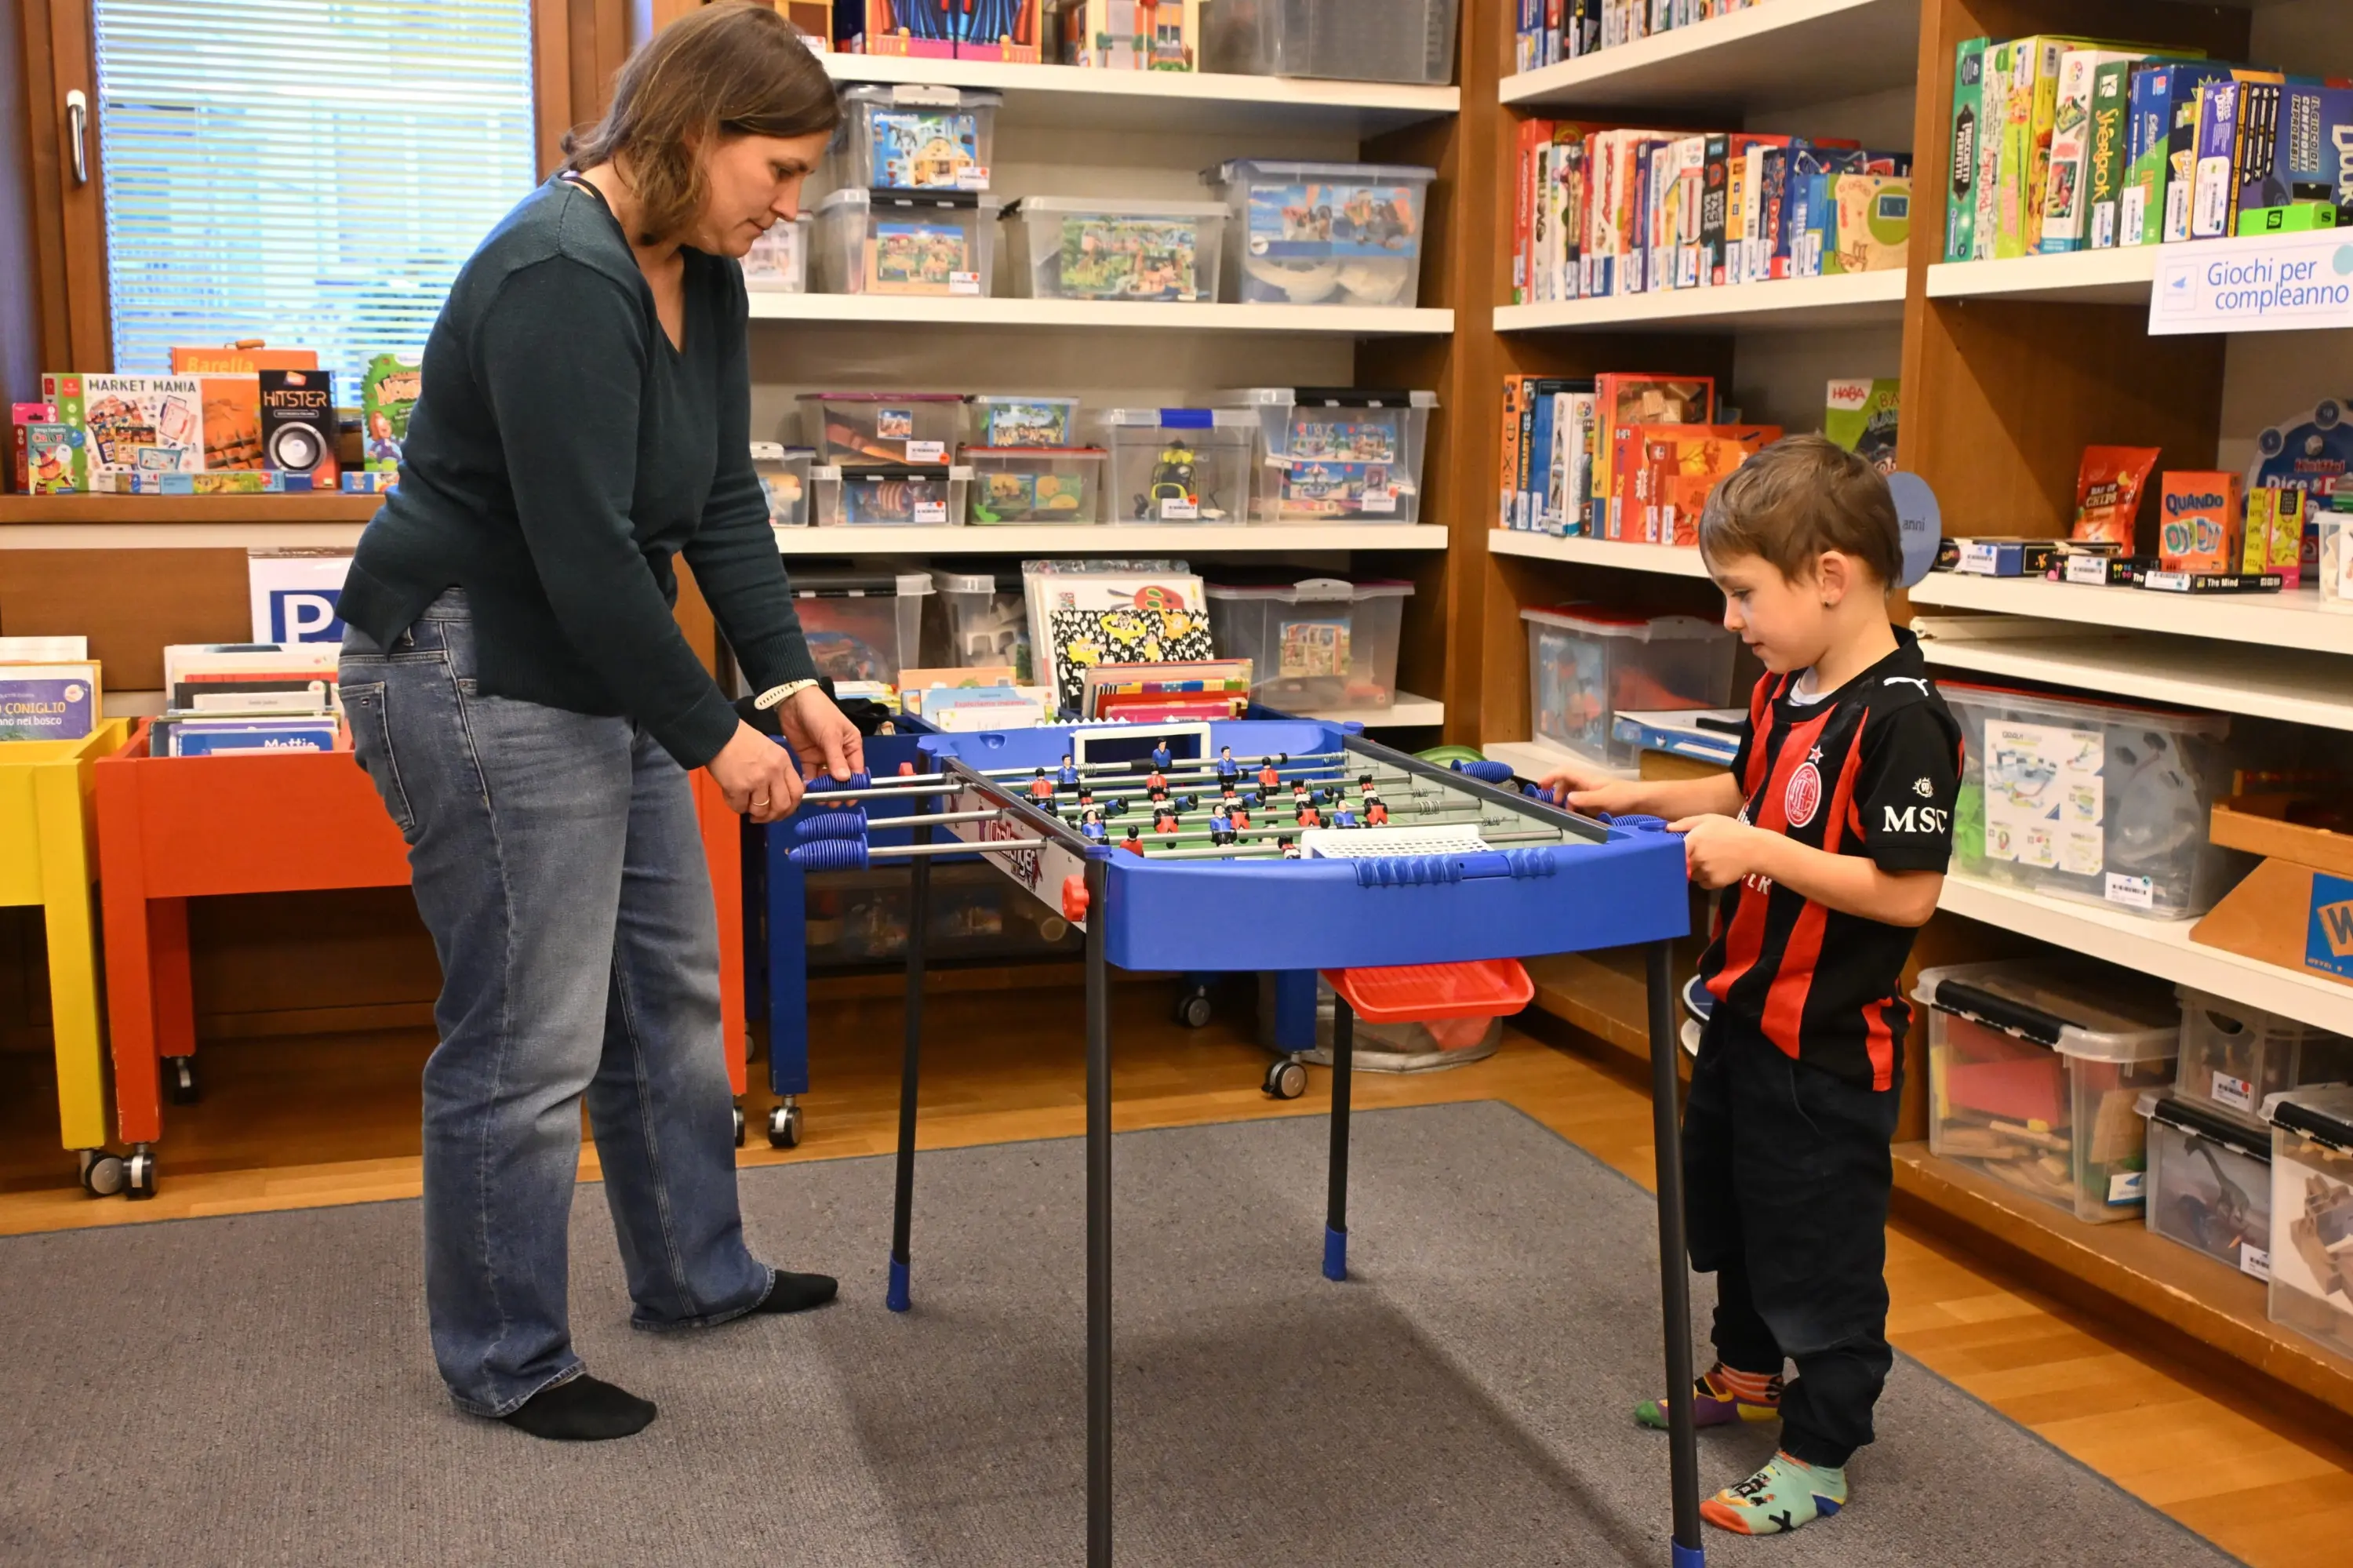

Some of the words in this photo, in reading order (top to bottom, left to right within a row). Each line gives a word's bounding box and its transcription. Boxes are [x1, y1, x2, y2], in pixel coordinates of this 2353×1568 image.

[2311, 96, 2320, 109] IL
[2290, 94, 2300, 172] IMPROBABILI
[2300, 96, 2309, 172] CONFRONTI
[2310, 112, 2319, 148] GIOCO
[1955, 130, 1966, 180] PERFETTI
[1962, 121, 1973, 183] TRUCCHETTI
[2310, 152, 2318, 172] DEI
[2207, 258, 2273, 286] Giochi
[2279, 260, 2318, 287] per
[2215, 282, 2349, 314] compleanno
[89, 380, 146, 391] MARKET
[154, 380, 196, 392] MANIA
[1832, 386, 1866, 402] HABA
[2086, 493, 2118, 507] CHIPS
[1903, 517, 1926, 532] anni
[2207, 577, 2220, 587] The
[2221, 577, 2238, 587] Mind
[283, 594, 334, 642] P
[5, 701, 66, 715] CONIGLIO
[16, 717, 31, 726] nel
[33, 715, 62, 726] bosco
[1882, 806, 1948, 835] MSC
